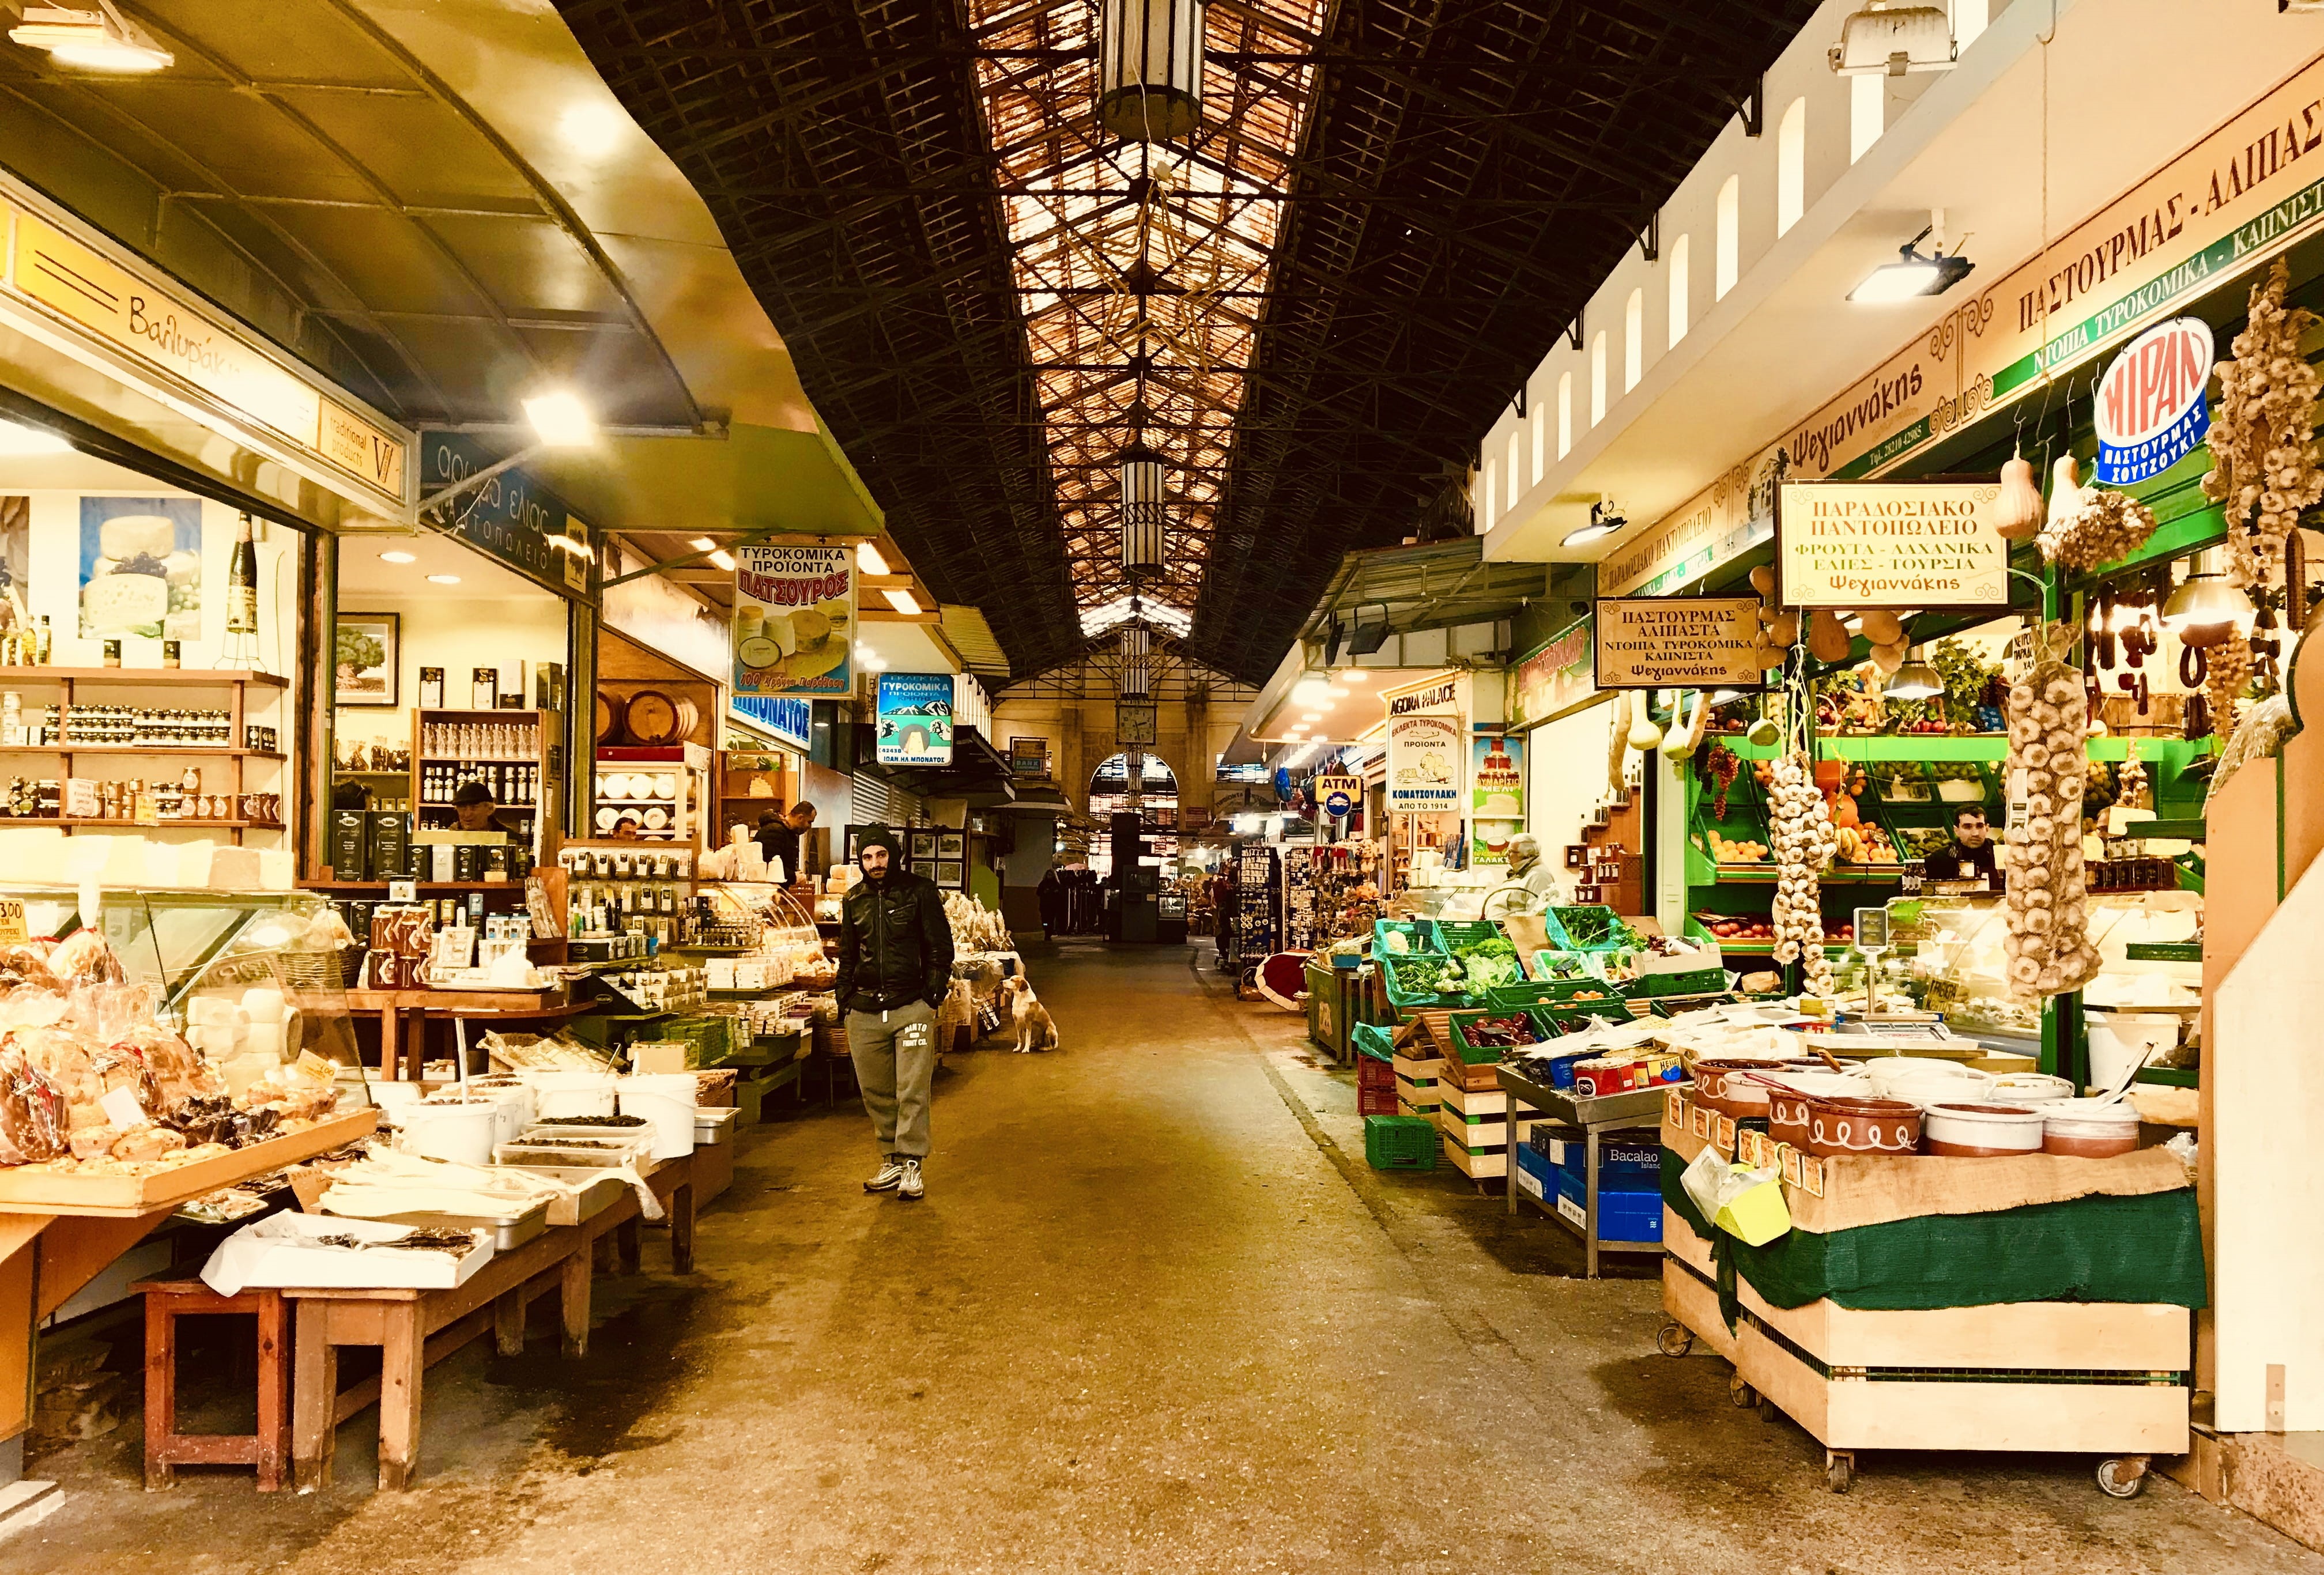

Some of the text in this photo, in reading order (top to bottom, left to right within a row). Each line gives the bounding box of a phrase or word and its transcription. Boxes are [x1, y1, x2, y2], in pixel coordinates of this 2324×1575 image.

[2019, 97, 2324, 333] ΠΑΣΤΟΥΡΜΑΣ ΑΛΙΠΑΣ
[2033, 324, 2089, 374] ΝΤΟΠΙΑ
[2095, 252, 2209, 338] ΤΥΡΟΚΟΜΙΚΑ
[330, 416, 367, 450] traditional
[2104, 405, 2202, 465] ΠΑΣΤΟΥΡΜΑΣ
[332, 439, 363, 467] products
[2111, 430, 2195, 483] ΣΟΥΤΖΟΥΚΙ
[1813, 500, 1975, 518] ΠΑΡΑΔΟΣΙΑΚΟ
[1810, 519, 1978, 536] ΠΑΝΤΟΠΩΛΕΙΟ
[741, 547, 845, 561] ΤΥΡΟΚΟΜΙΚΑ
[1609, 506, 1711, 591] ΠΑΡΑΔΟΣΙΑΚΟ ΠΑΝΤΟΠΩΛΕΙΟ
[1795, 542, 1994, 556] ΦΡΟΥΤΑ ΛΑΧΑΝΙΚΑ
[752, 560, 835, 573] ΠΡΟΪΟΝΤΑ
[1813, 558, 1976, 571] ΕΛΙΕΣ ΤΟΥΡΣΙΑ
[738, 568, 849, 607] ΠΑΤΣΟΥΡΟΣ
[1622, 610, 1736, 624] ΠΑΣΤΟΥΡΜΑΣ
[1638, 624, 1721, 637] ΑΛΙΠΑΣΤΑ
[1605, 640, 1753, 651] ΝΤΟΠΙΑ ΤΥΡΟΚΟΜΙΚΑ
[1645, 652, 1713, 661] ΚΑΠΝΙΣΤΑ
[740, 673, 761, 686] 100
[881, 682, 949, 692] ΤΥΡΟΚΟΜΙΚΑ
[1421, 683, 1455, 708] PALACE
[1392, 719, 1457, 738] ΕΚΛΕΚΤΑ ΤΥΡΟΚΟΜΙΚΑ
[1322, 778, 1357, 790] ATM
[1393, 790, 1457, 799] ΚΟΜΑΤΣΟΥΛΑΚΗ
[1610, 1149, 1658, 1162] Bacalao
